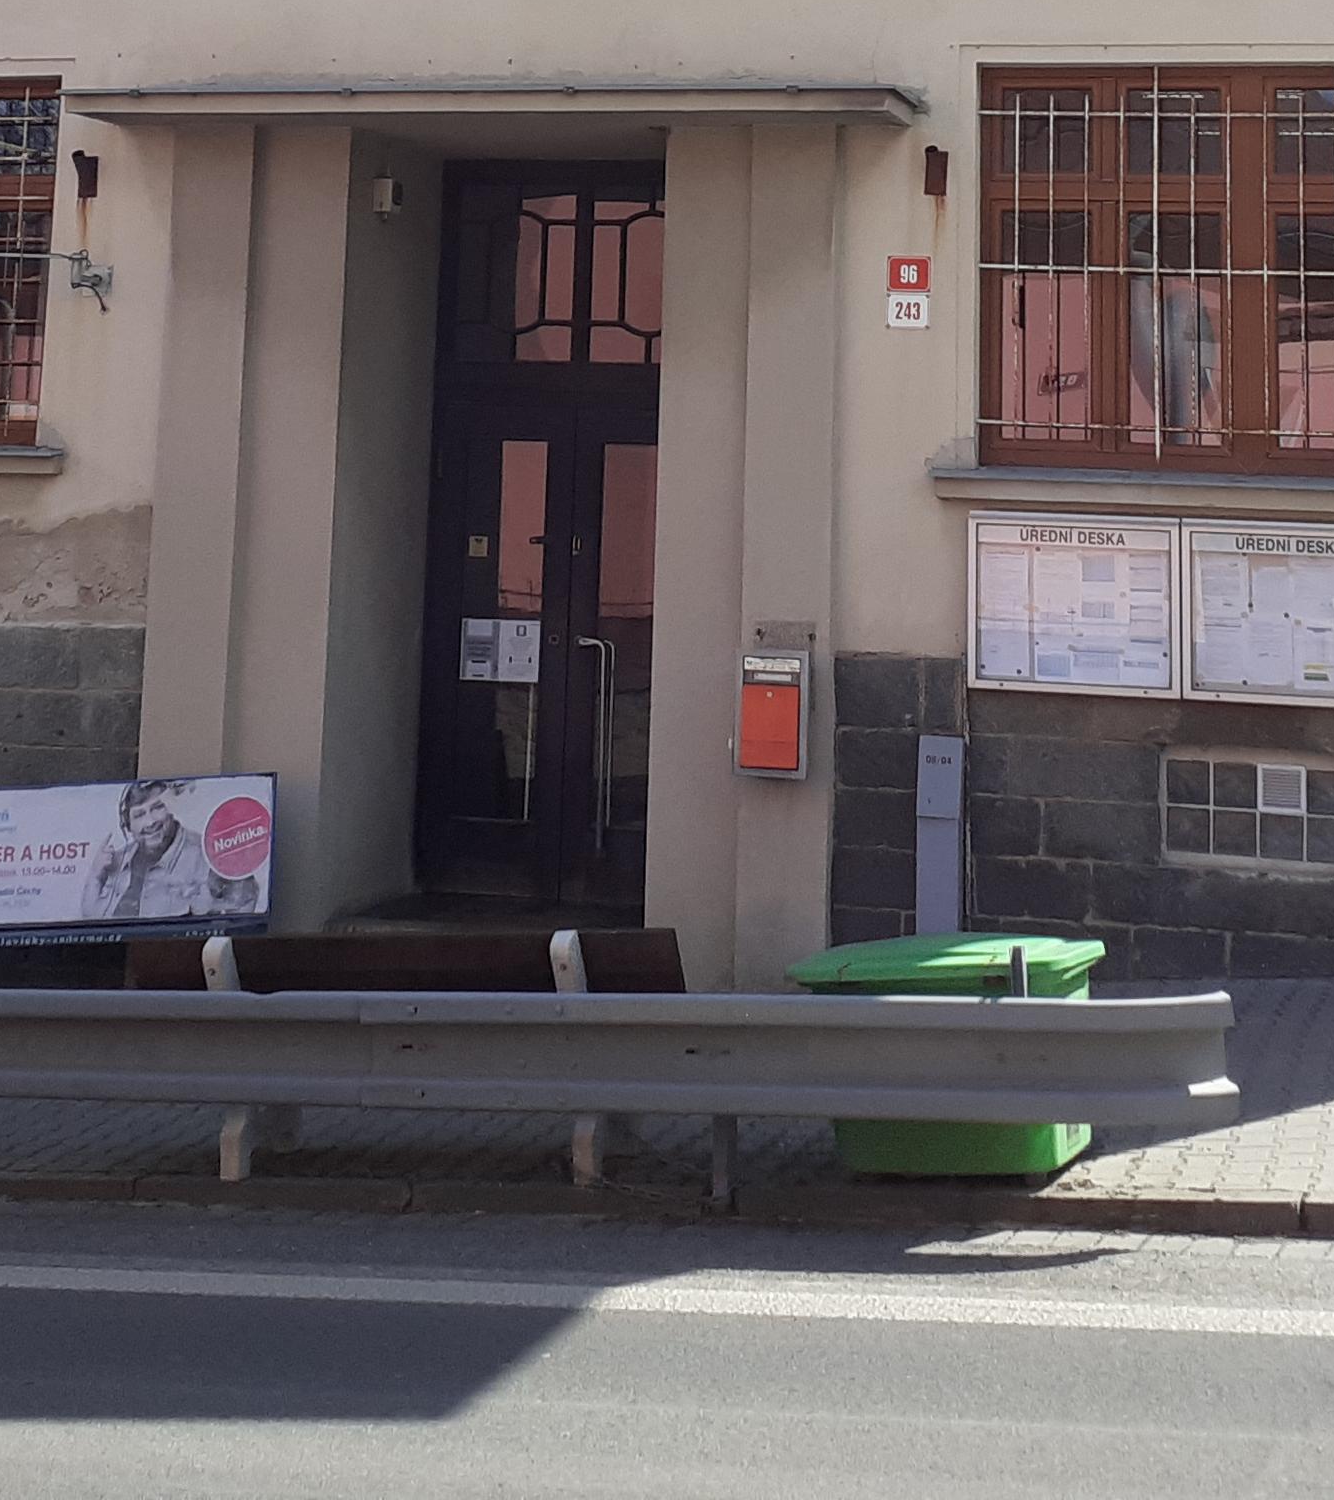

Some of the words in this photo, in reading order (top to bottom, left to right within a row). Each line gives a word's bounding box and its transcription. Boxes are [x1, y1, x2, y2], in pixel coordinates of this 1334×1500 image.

[899, 264, 918, 284] 96
[895, 301, 921, 320] 243
[1020, 525, 1073, 544] ÚŘEDNÍ
[1078, 531, 1126, 546] DESKA
[214, 826, 264, 854] Novinka
[20, 845, 33, 861] A
[40, 842, 90, 860] HOST
